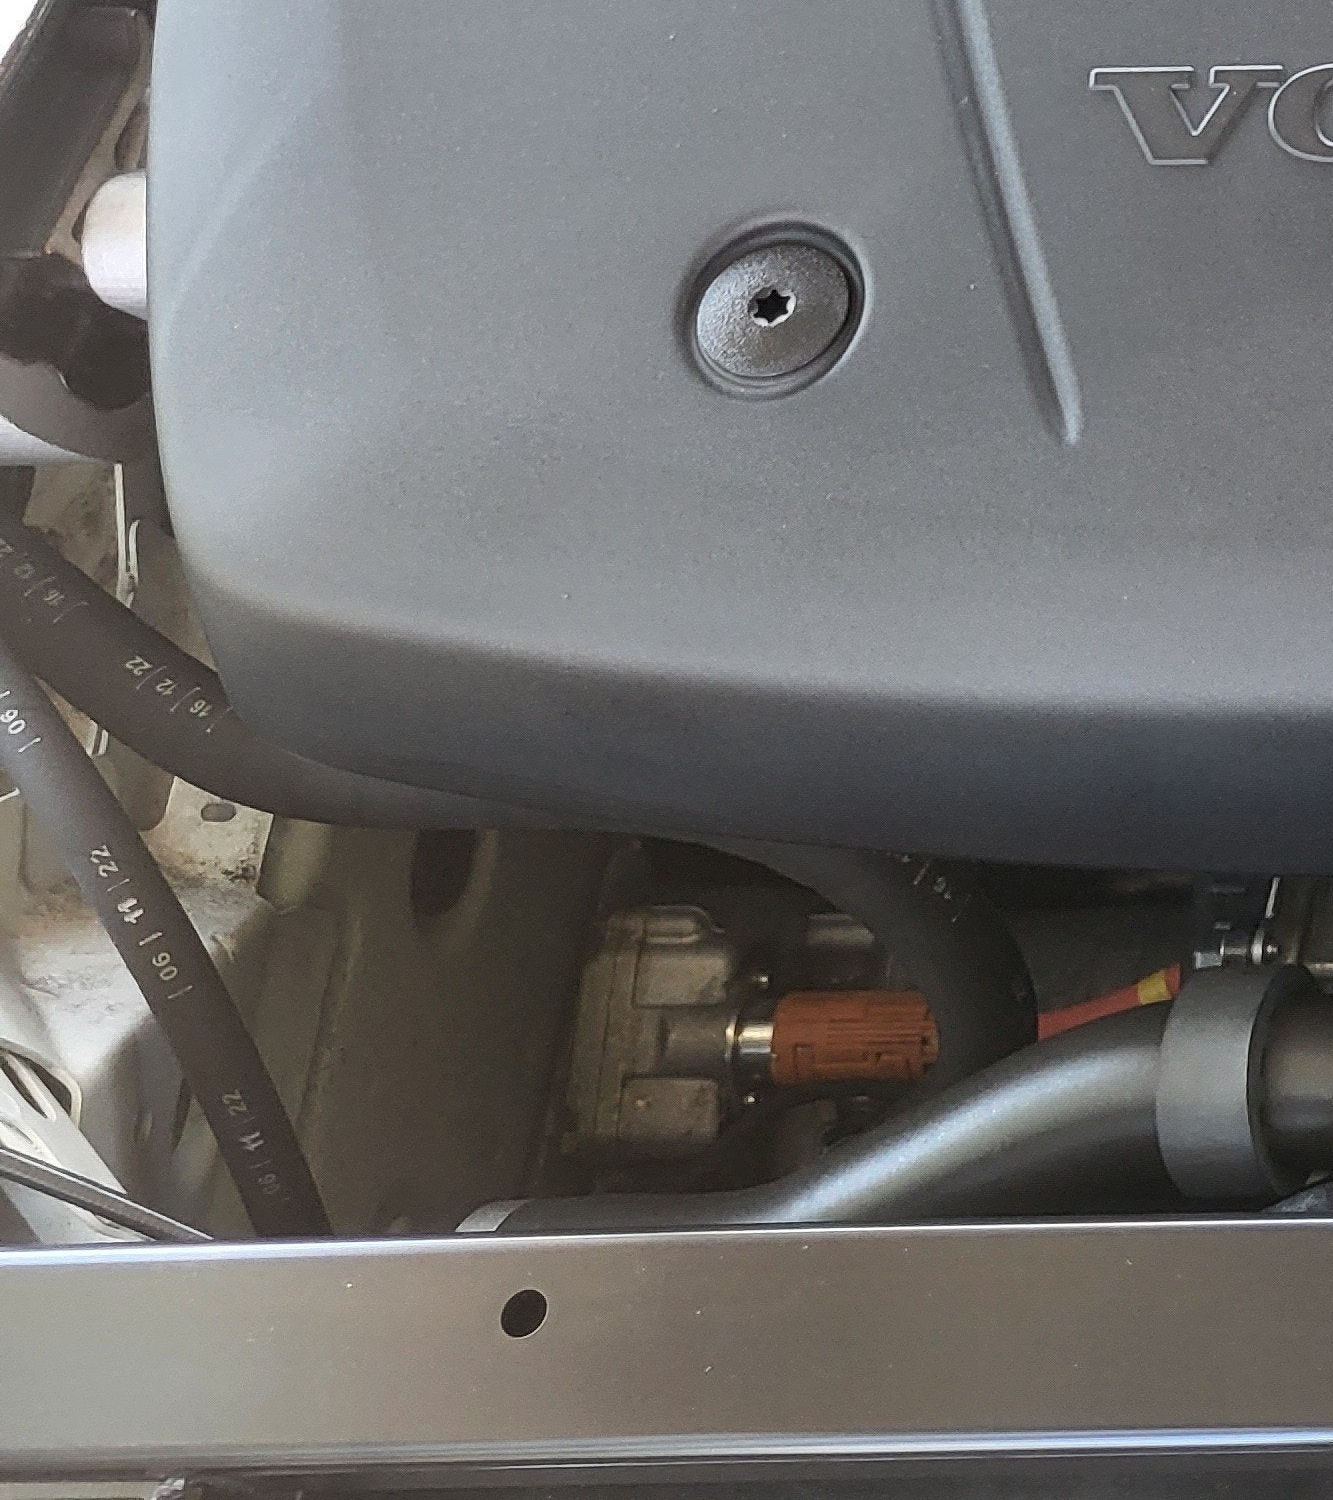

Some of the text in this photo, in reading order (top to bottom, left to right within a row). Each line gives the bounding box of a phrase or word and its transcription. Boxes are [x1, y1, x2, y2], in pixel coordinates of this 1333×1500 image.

[125, 655, 153, 676] 22
[90, 844, 119, 877] 22
[152, 952, 178, 980] 06
[222, 1088, 247, 1116] 22
